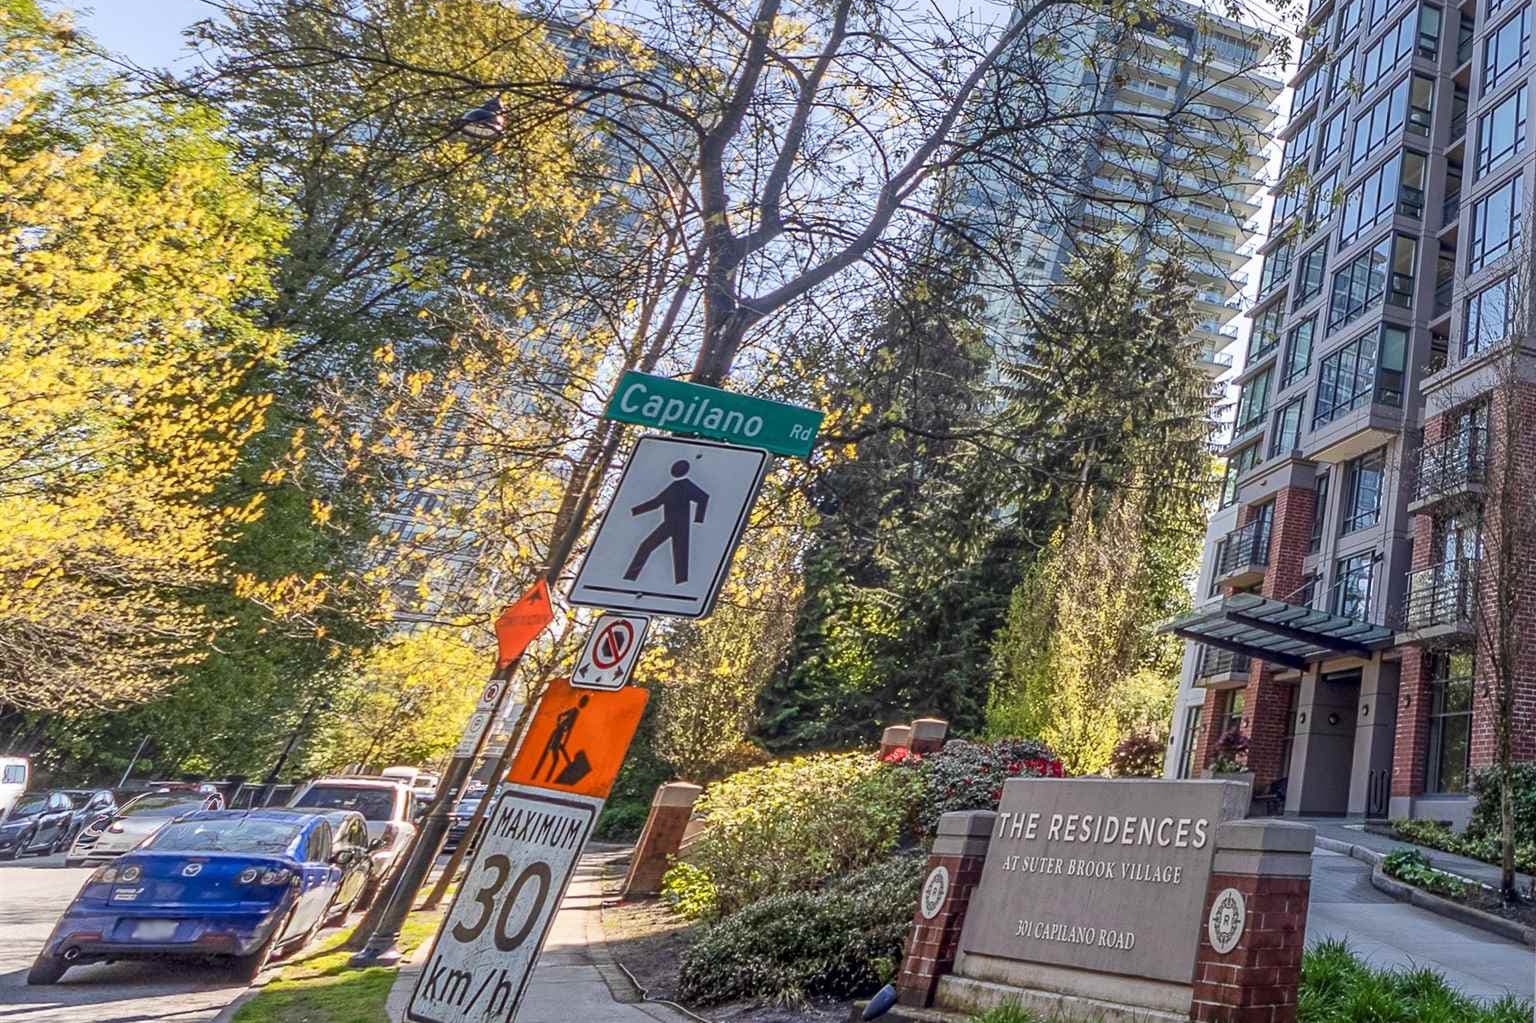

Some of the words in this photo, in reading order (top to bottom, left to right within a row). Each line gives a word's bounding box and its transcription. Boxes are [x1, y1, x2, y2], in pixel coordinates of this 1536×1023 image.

[619, 382, 764, 437] Capilano
[789, 424, 813, 440] Rd
[492, 806, 584, 851] MAXIMUM
[999, 812, 1041, 839] THE
[1047, 814, 1209, 849] RESIDENCES
[1002, 856, 1020, 871] AT
[1022, 857, 1063, 874] SUTER
[1067, 859, 1117, 879] BROOK
[1120, 862, 1183, 884] VILLAGE
[452, 854, 552, 953] 30
[1015, 919, 1033, 937] 301
[1034, 921, 1096, 945] CAPILANO
[1097, 928, 1136, 950] ROAD
[423, 954, 514, 1018] km/h
